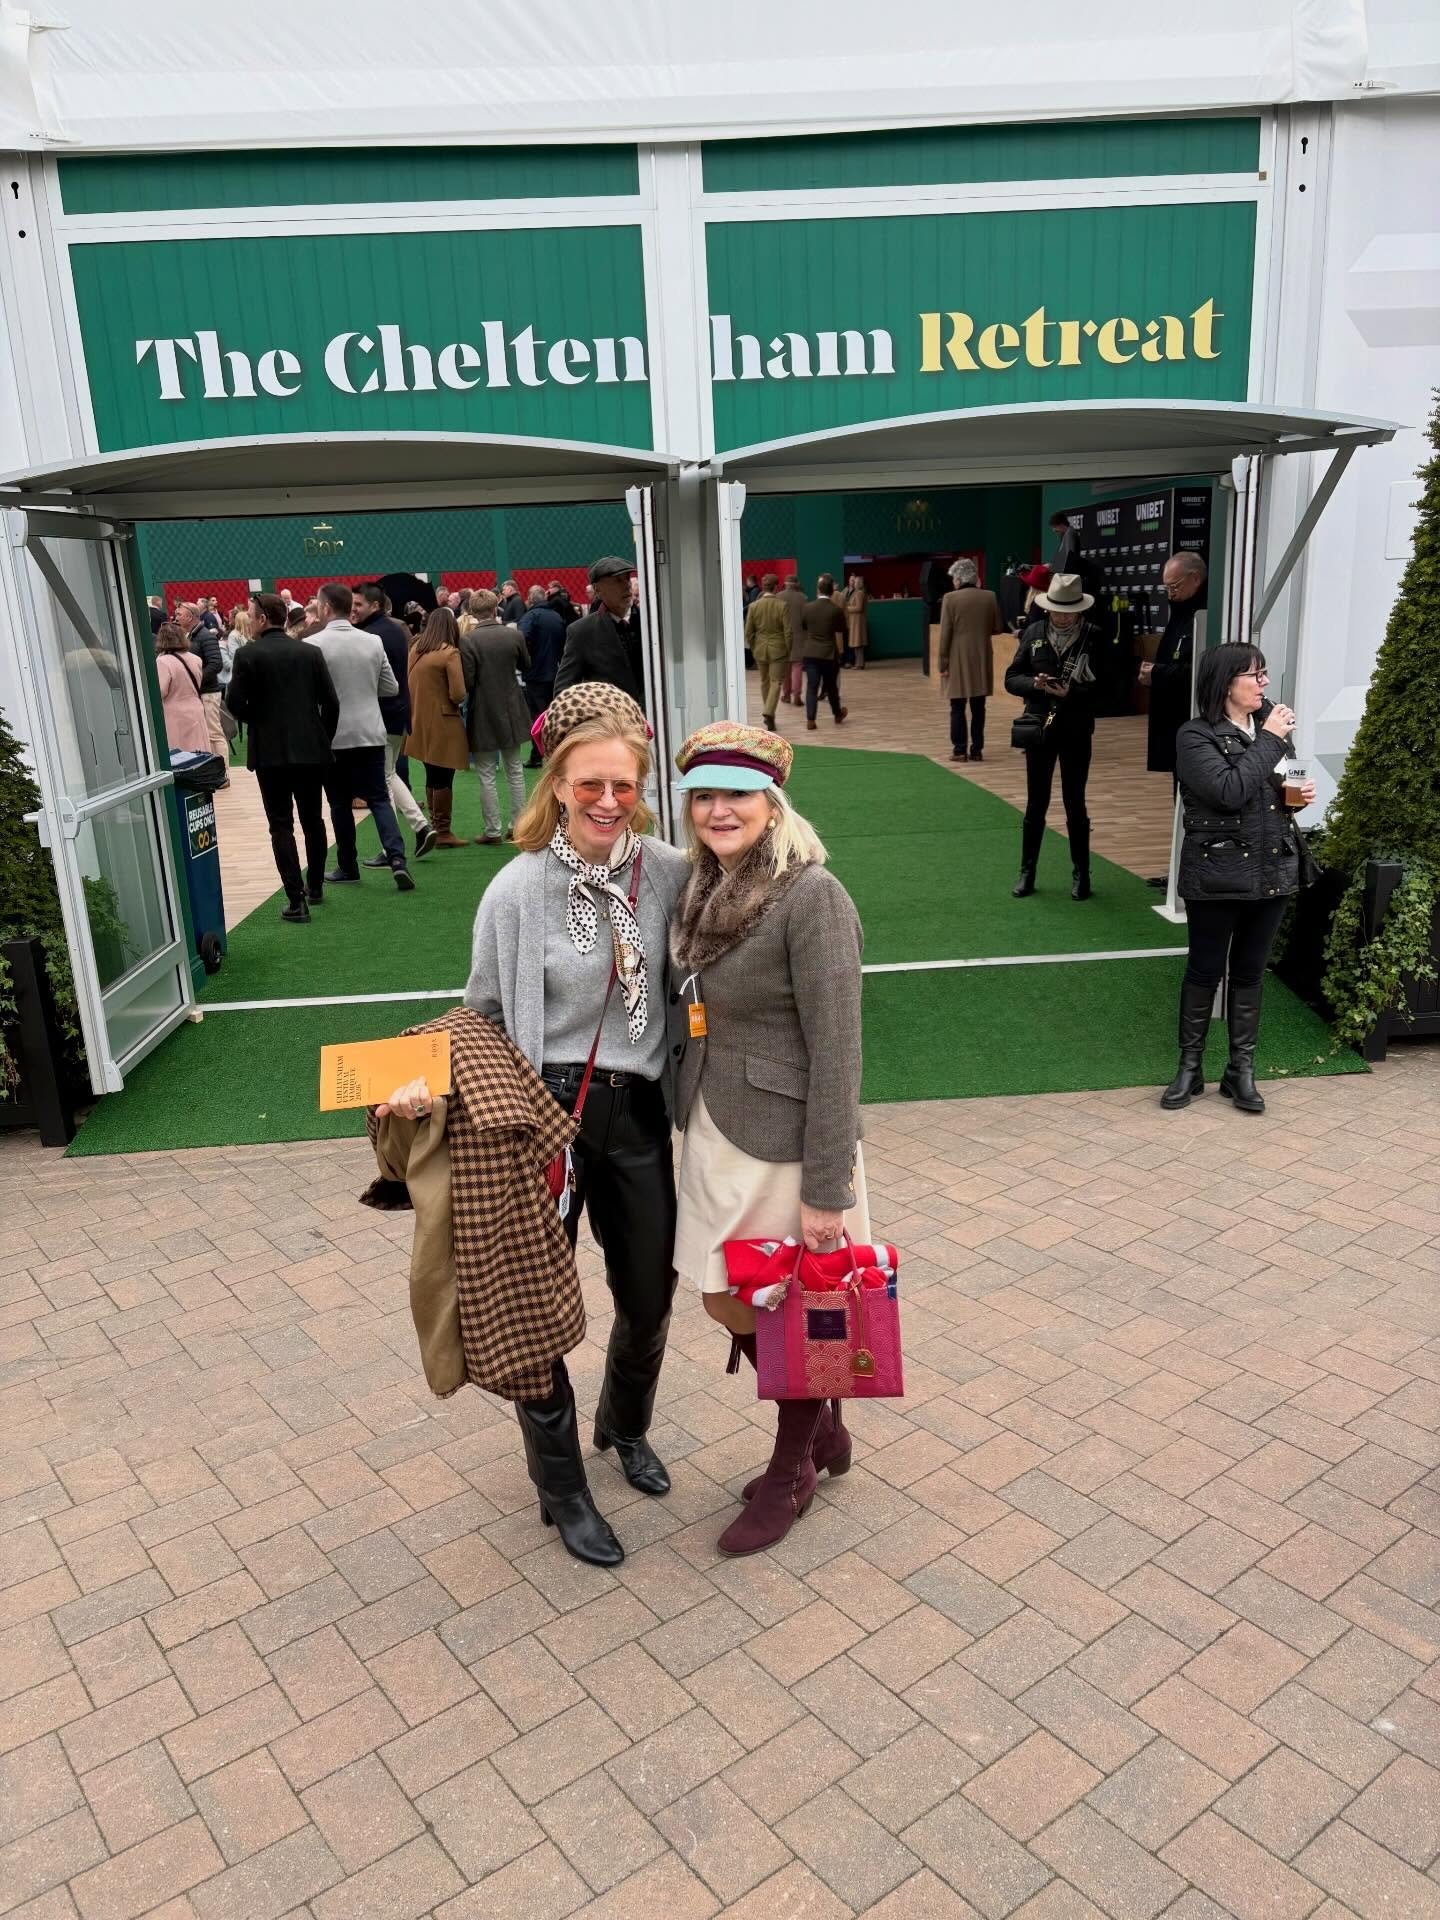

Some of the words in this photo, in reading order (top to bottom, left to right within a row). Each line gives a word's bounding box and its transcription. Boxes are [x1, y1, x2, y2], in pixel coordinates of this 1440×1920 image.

[136, 330, 302, 400] The
[918, 297, 1225, 372] Retreat
[1096, 508, 1120, 526] UNIBET
[1136, 500, 1165, 520] UNIBET
[304, 537, 344, 556] Bar
[188, 803, 213, 821] REUSABLE
[190, 819, 203, 833] CUPS
